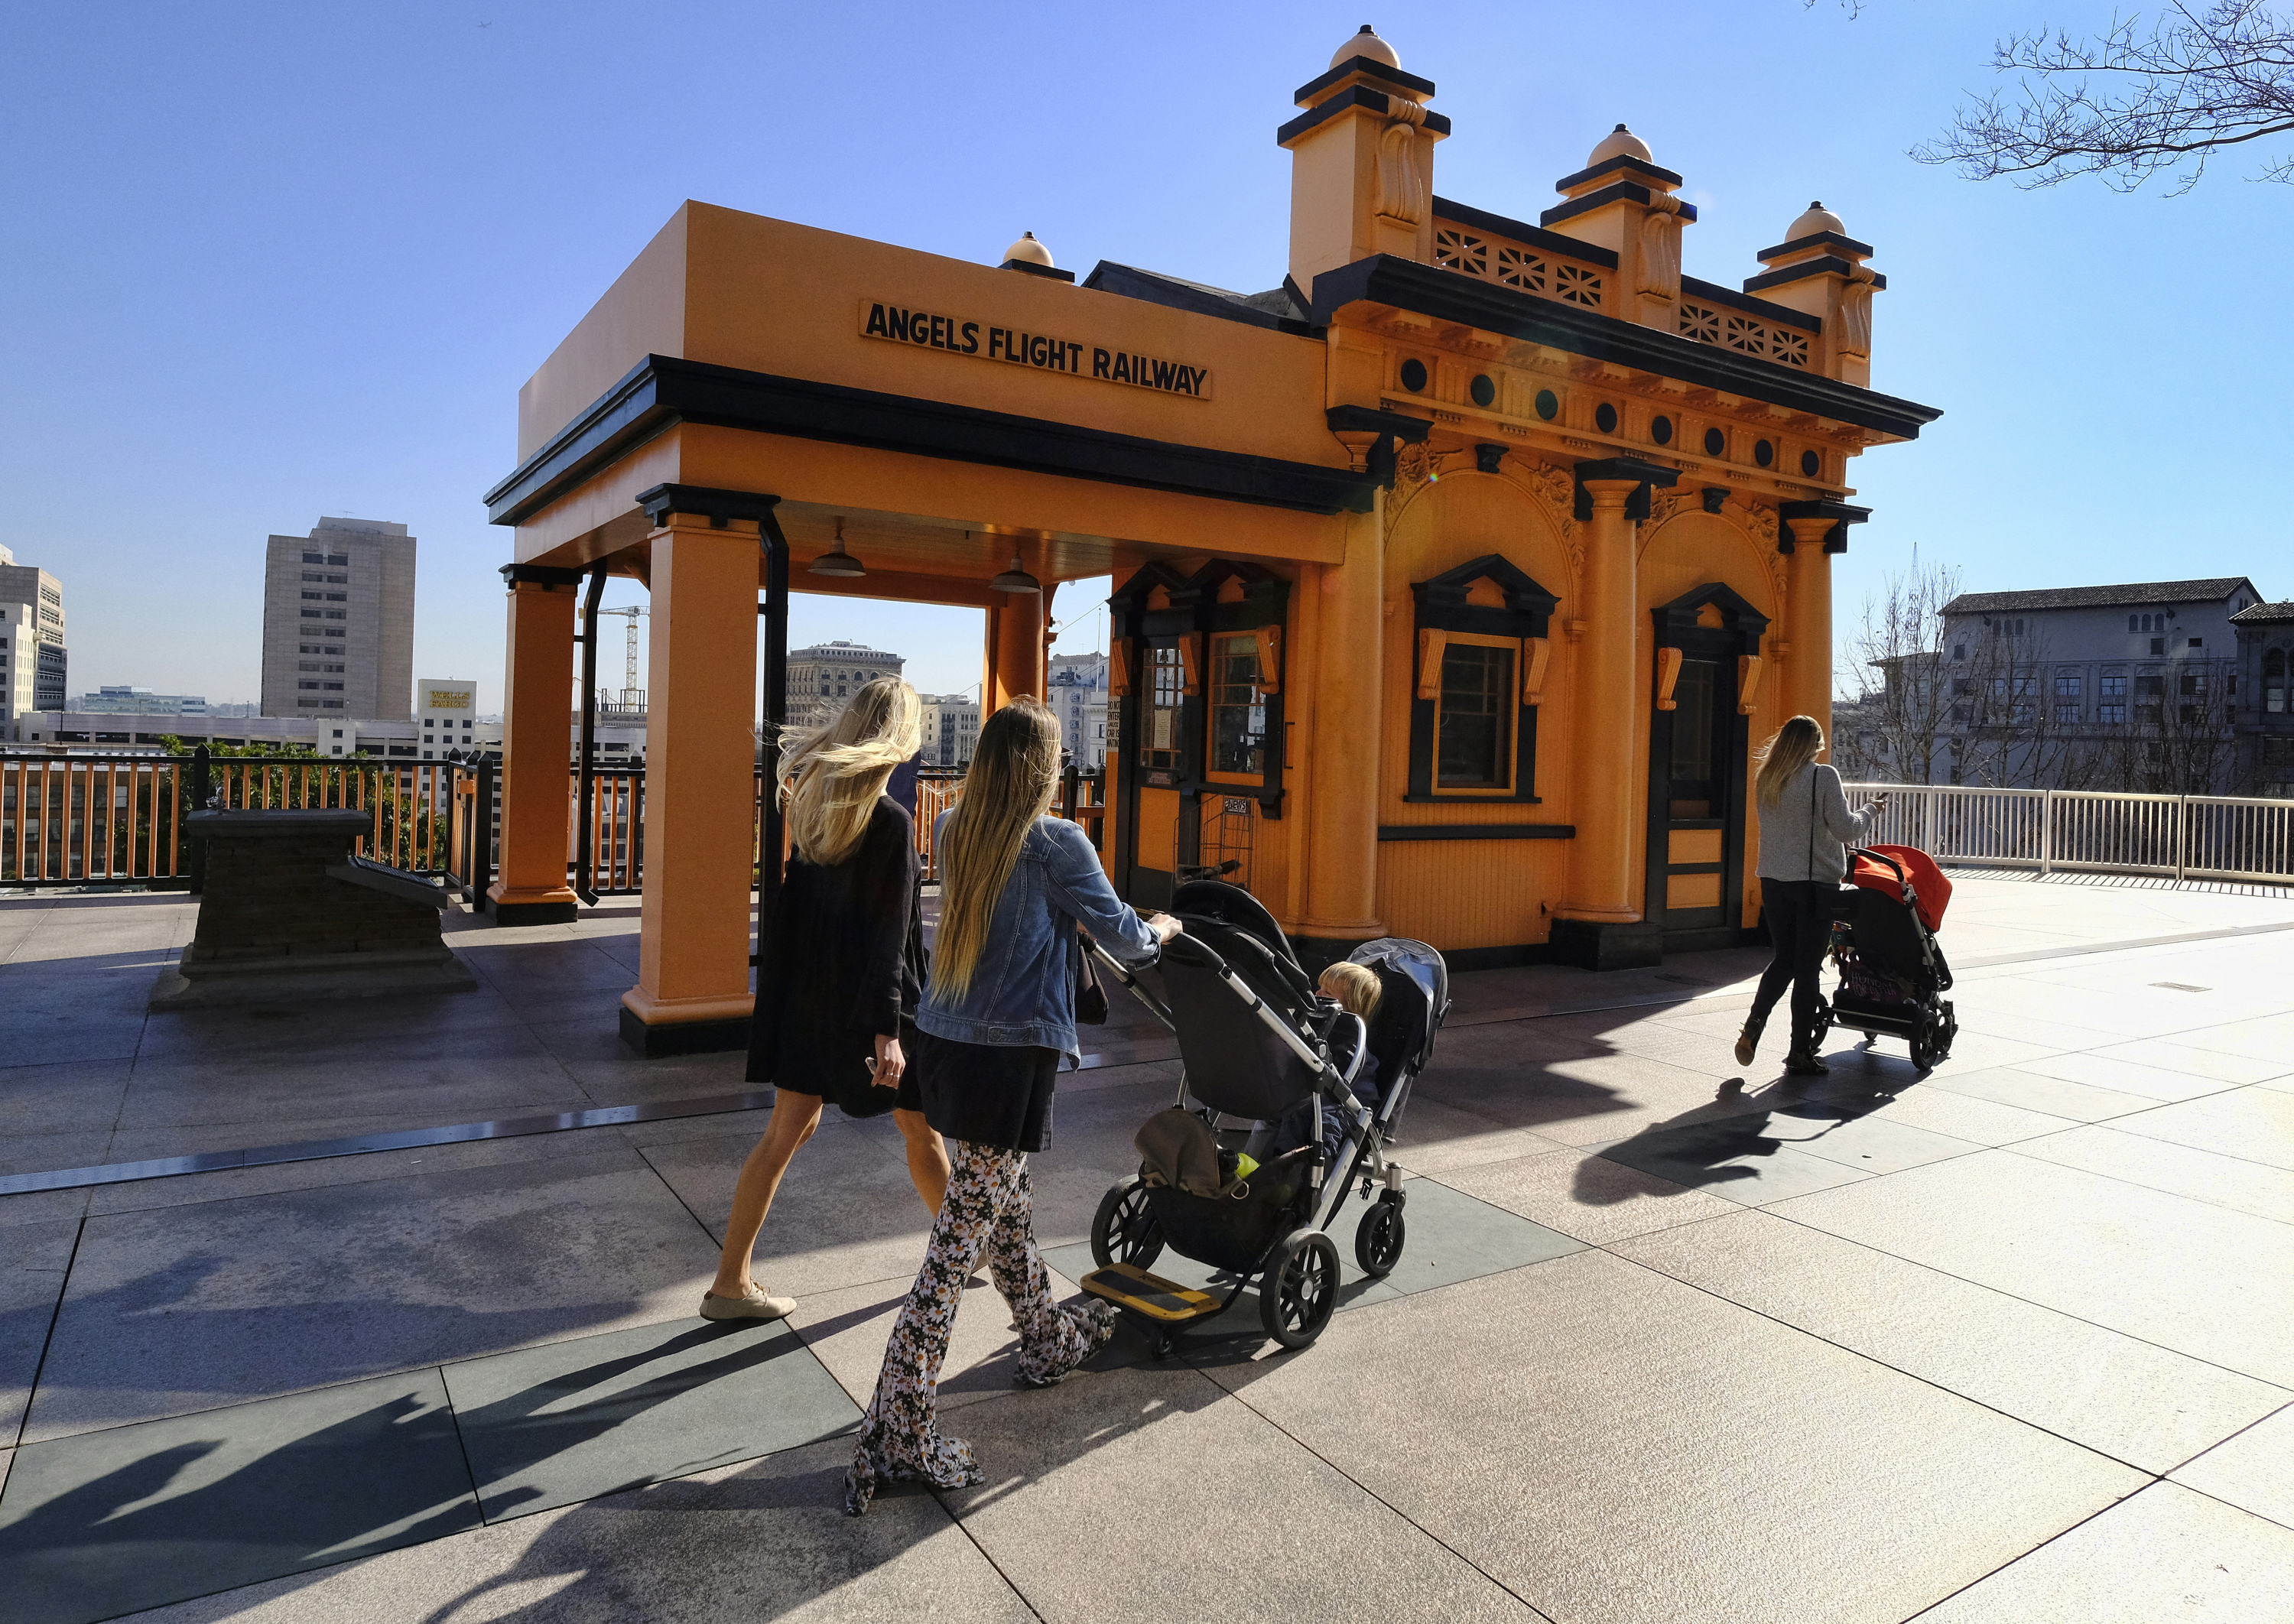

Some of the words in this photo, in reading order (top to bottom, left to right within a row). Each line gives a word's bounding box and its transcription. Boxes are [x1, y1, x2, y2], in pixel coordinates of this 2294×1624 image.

[866, 303, 979, 354] ANGELS
[989, 326, 1083, 373] FLIGHT
[1093, 347, 1207, 396] RAILWAY
[430, 691, 470, 700] WELLS
[430, 700, 469, 708] FARGO
[1107, 700, 1113, 710] DO
[1106, 729, 1115, 737] CAR
[1228, 799, 1245, 810] NEWS
[1852, 983, 1867, 996] FOR
